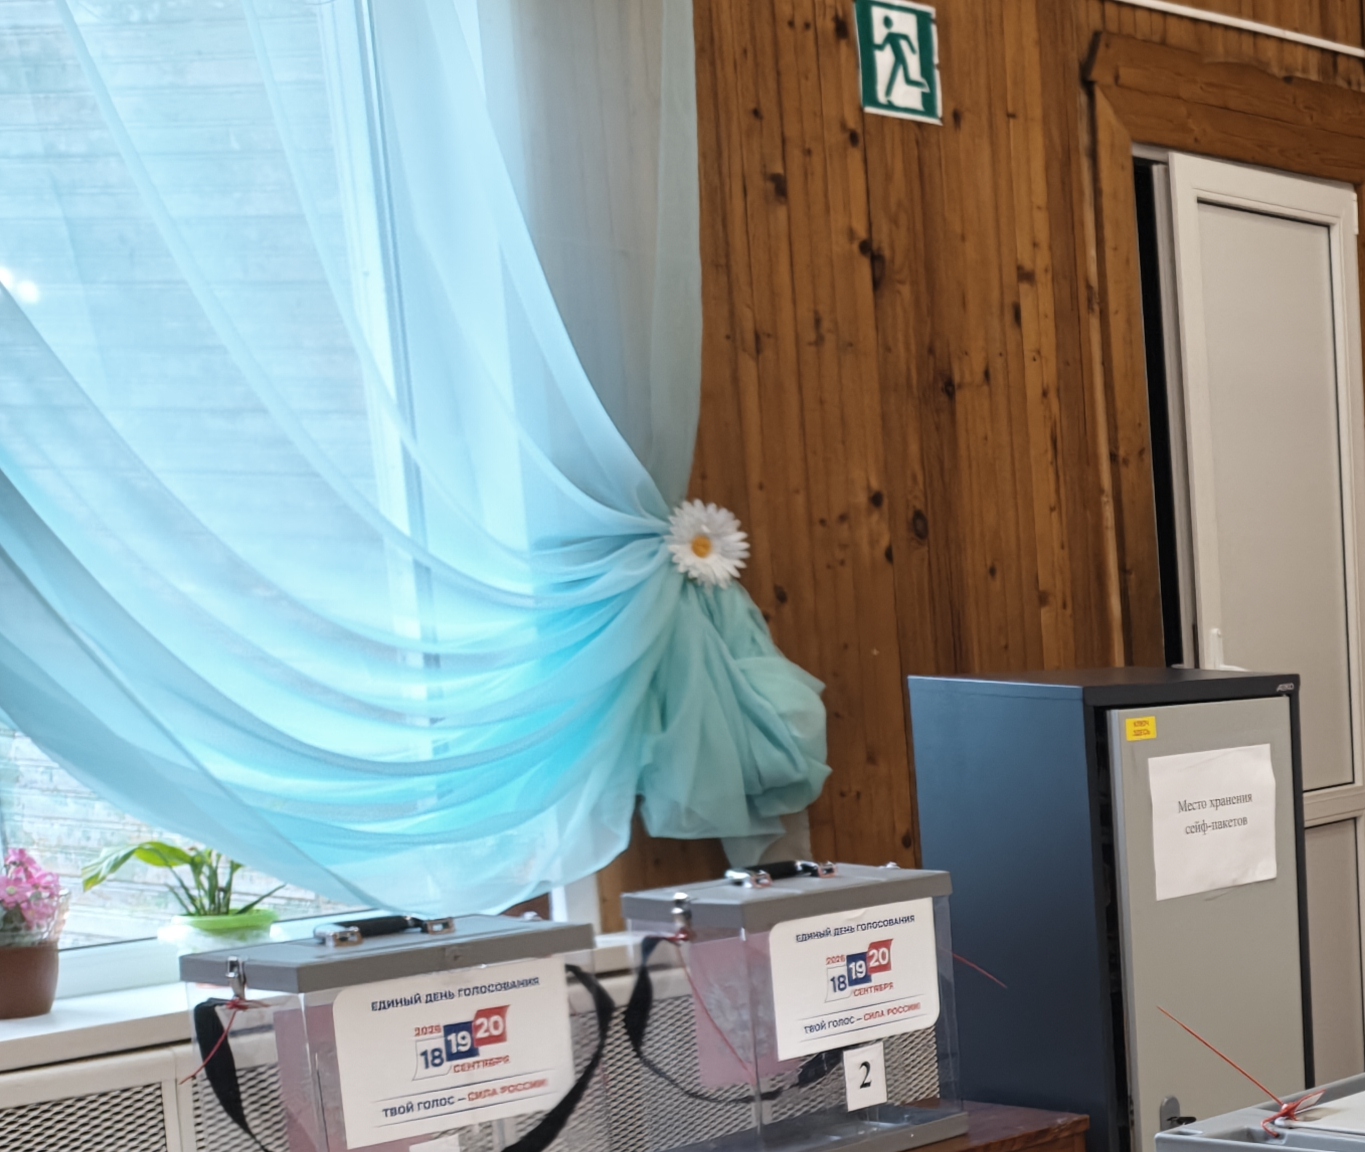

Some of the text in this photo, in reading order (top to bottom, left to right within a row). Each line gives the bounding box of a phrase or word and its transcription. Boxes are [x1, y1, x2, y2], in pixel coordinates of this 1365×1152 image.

[1178, 793, 1253, 813] Место хранения
[1185, 816, 1248, 835] сейф-пакетов
[796, 914, 915, 943] ЕДИНЫЙ ДЕНЬ ГОЛОСОВАНИЯ
[826, 954, 845, 965] 2026
[830, 947, 889, 993] 18 19 20
[371, 977, 540, 1011] ЕДИНЫЙ ДЕНЬ ГОЛОСОВАНИЯ
[854, 982, 894, 997] СЕНТЯБРЯ
[804, 1019, 827, 1034] ТВОЙ
[828, 1016, 855, 1028] ГОЛОС
[864, 1009, 885, 1021] СИЛА
[420, 1015, 504, 1069] 18 19 20
[453, 1055, 510, 1073] СЕНТЯБРЯ
[859, 1060, 872, 1090] 2
[382, 1102, 414, 1118] ТВОЙ
[417, 1096, 455, 1111] ГОЛОС
[467, 1086, 498, 1102] СИЛА
